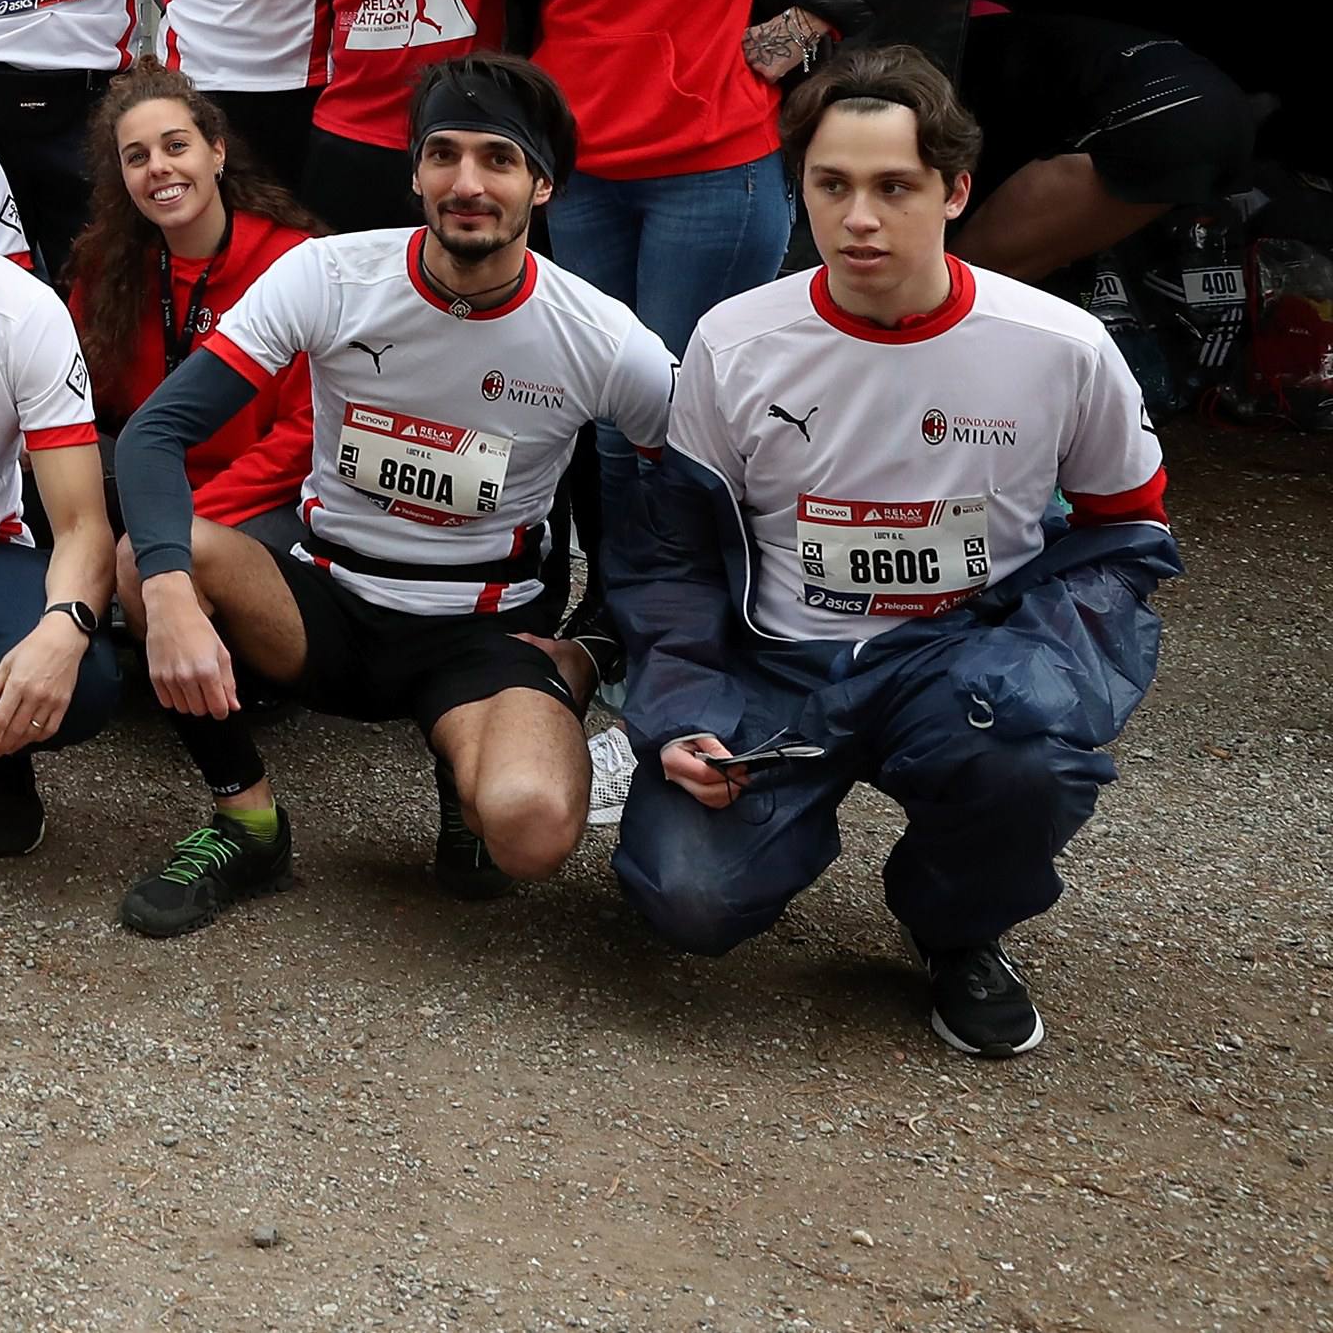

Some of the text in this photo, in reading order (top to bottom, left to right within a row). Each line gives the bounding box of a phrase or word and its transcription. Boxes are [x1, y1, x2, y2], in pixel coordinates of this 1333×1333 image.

[1202, 272, 1237, 295] 400
[510, 378, 565, 395] FONDAZIONE
[507, 388, 564, 409] MILAN
[355, 412, 390, 427] Lenovo
[953, 417, 1017, 430] FONDAZIONE
[420, 425, 453, 440] RELAY
[952, 427, 1017, 446] MILAN
[406, 447, 420, 458] LUCY
[378, 458, 454, 507] 860A
[809, 505, 847, 517] Lenovo
[884, 508, 921, 517] RELAY
[874, 532, 890, 540] LUCY
[849, 547, 941, 585] 860C
[826, 597, 863, 612] asics
[883, 602, 924, 612] Telepass
